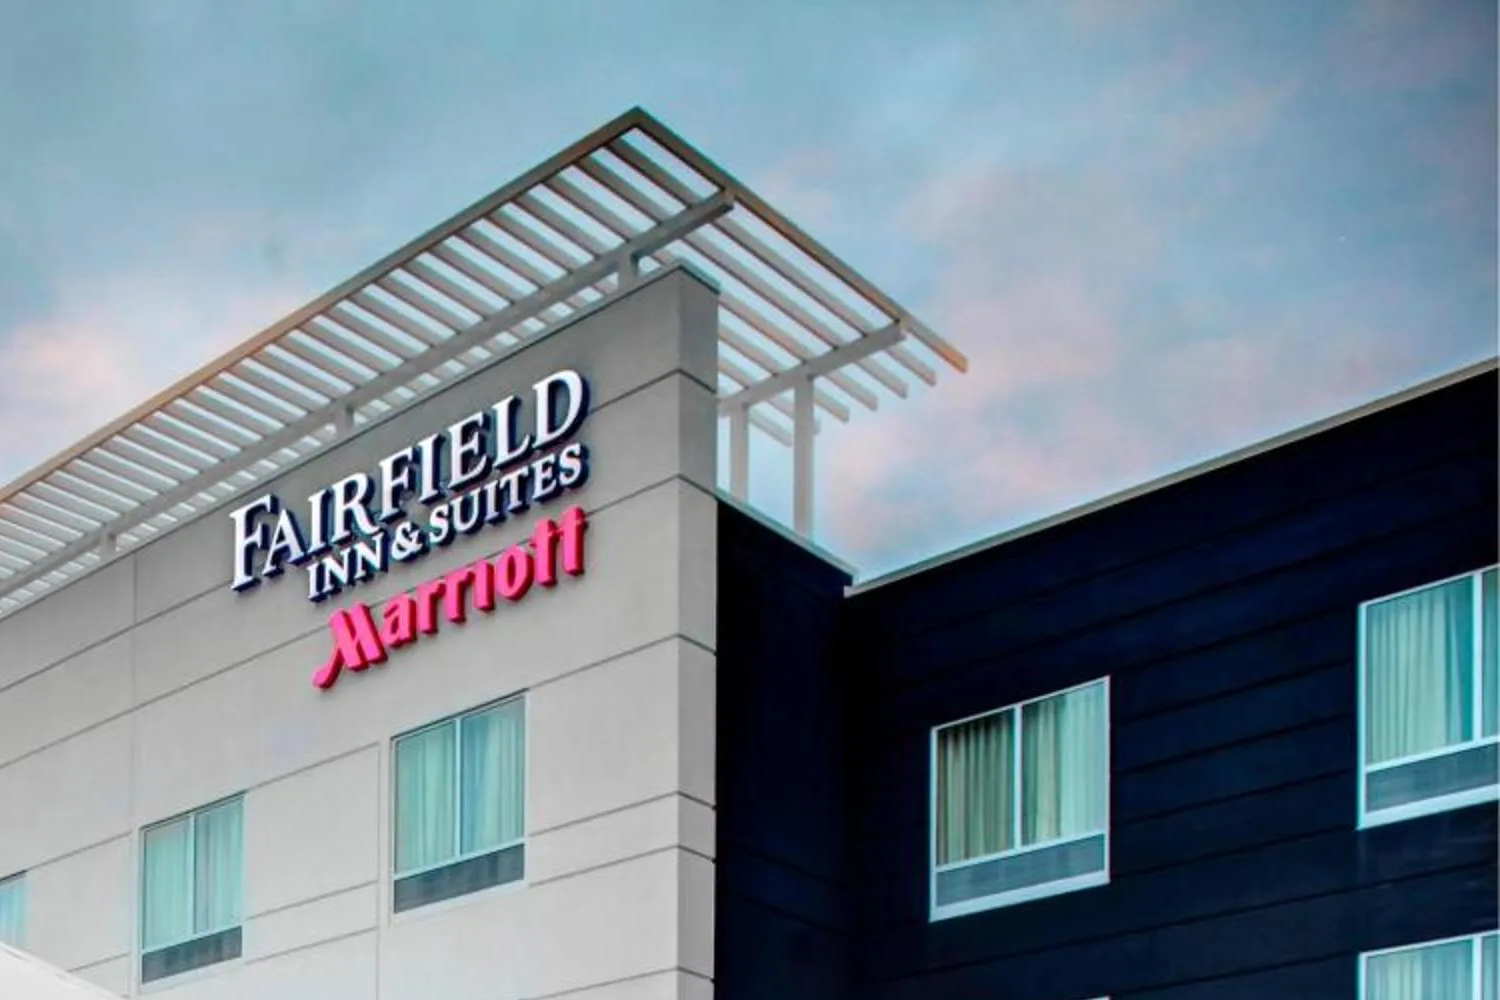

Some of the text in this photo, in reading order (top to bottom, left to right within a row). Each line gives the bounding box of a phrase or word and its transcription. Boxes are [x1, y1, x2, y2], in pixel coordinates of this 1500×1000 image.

[229, 368, 591, 593] FAIRFIELD
[307, 443, 588, 602] INN & SUITES
[312, 505, 589, 690] Marriott
